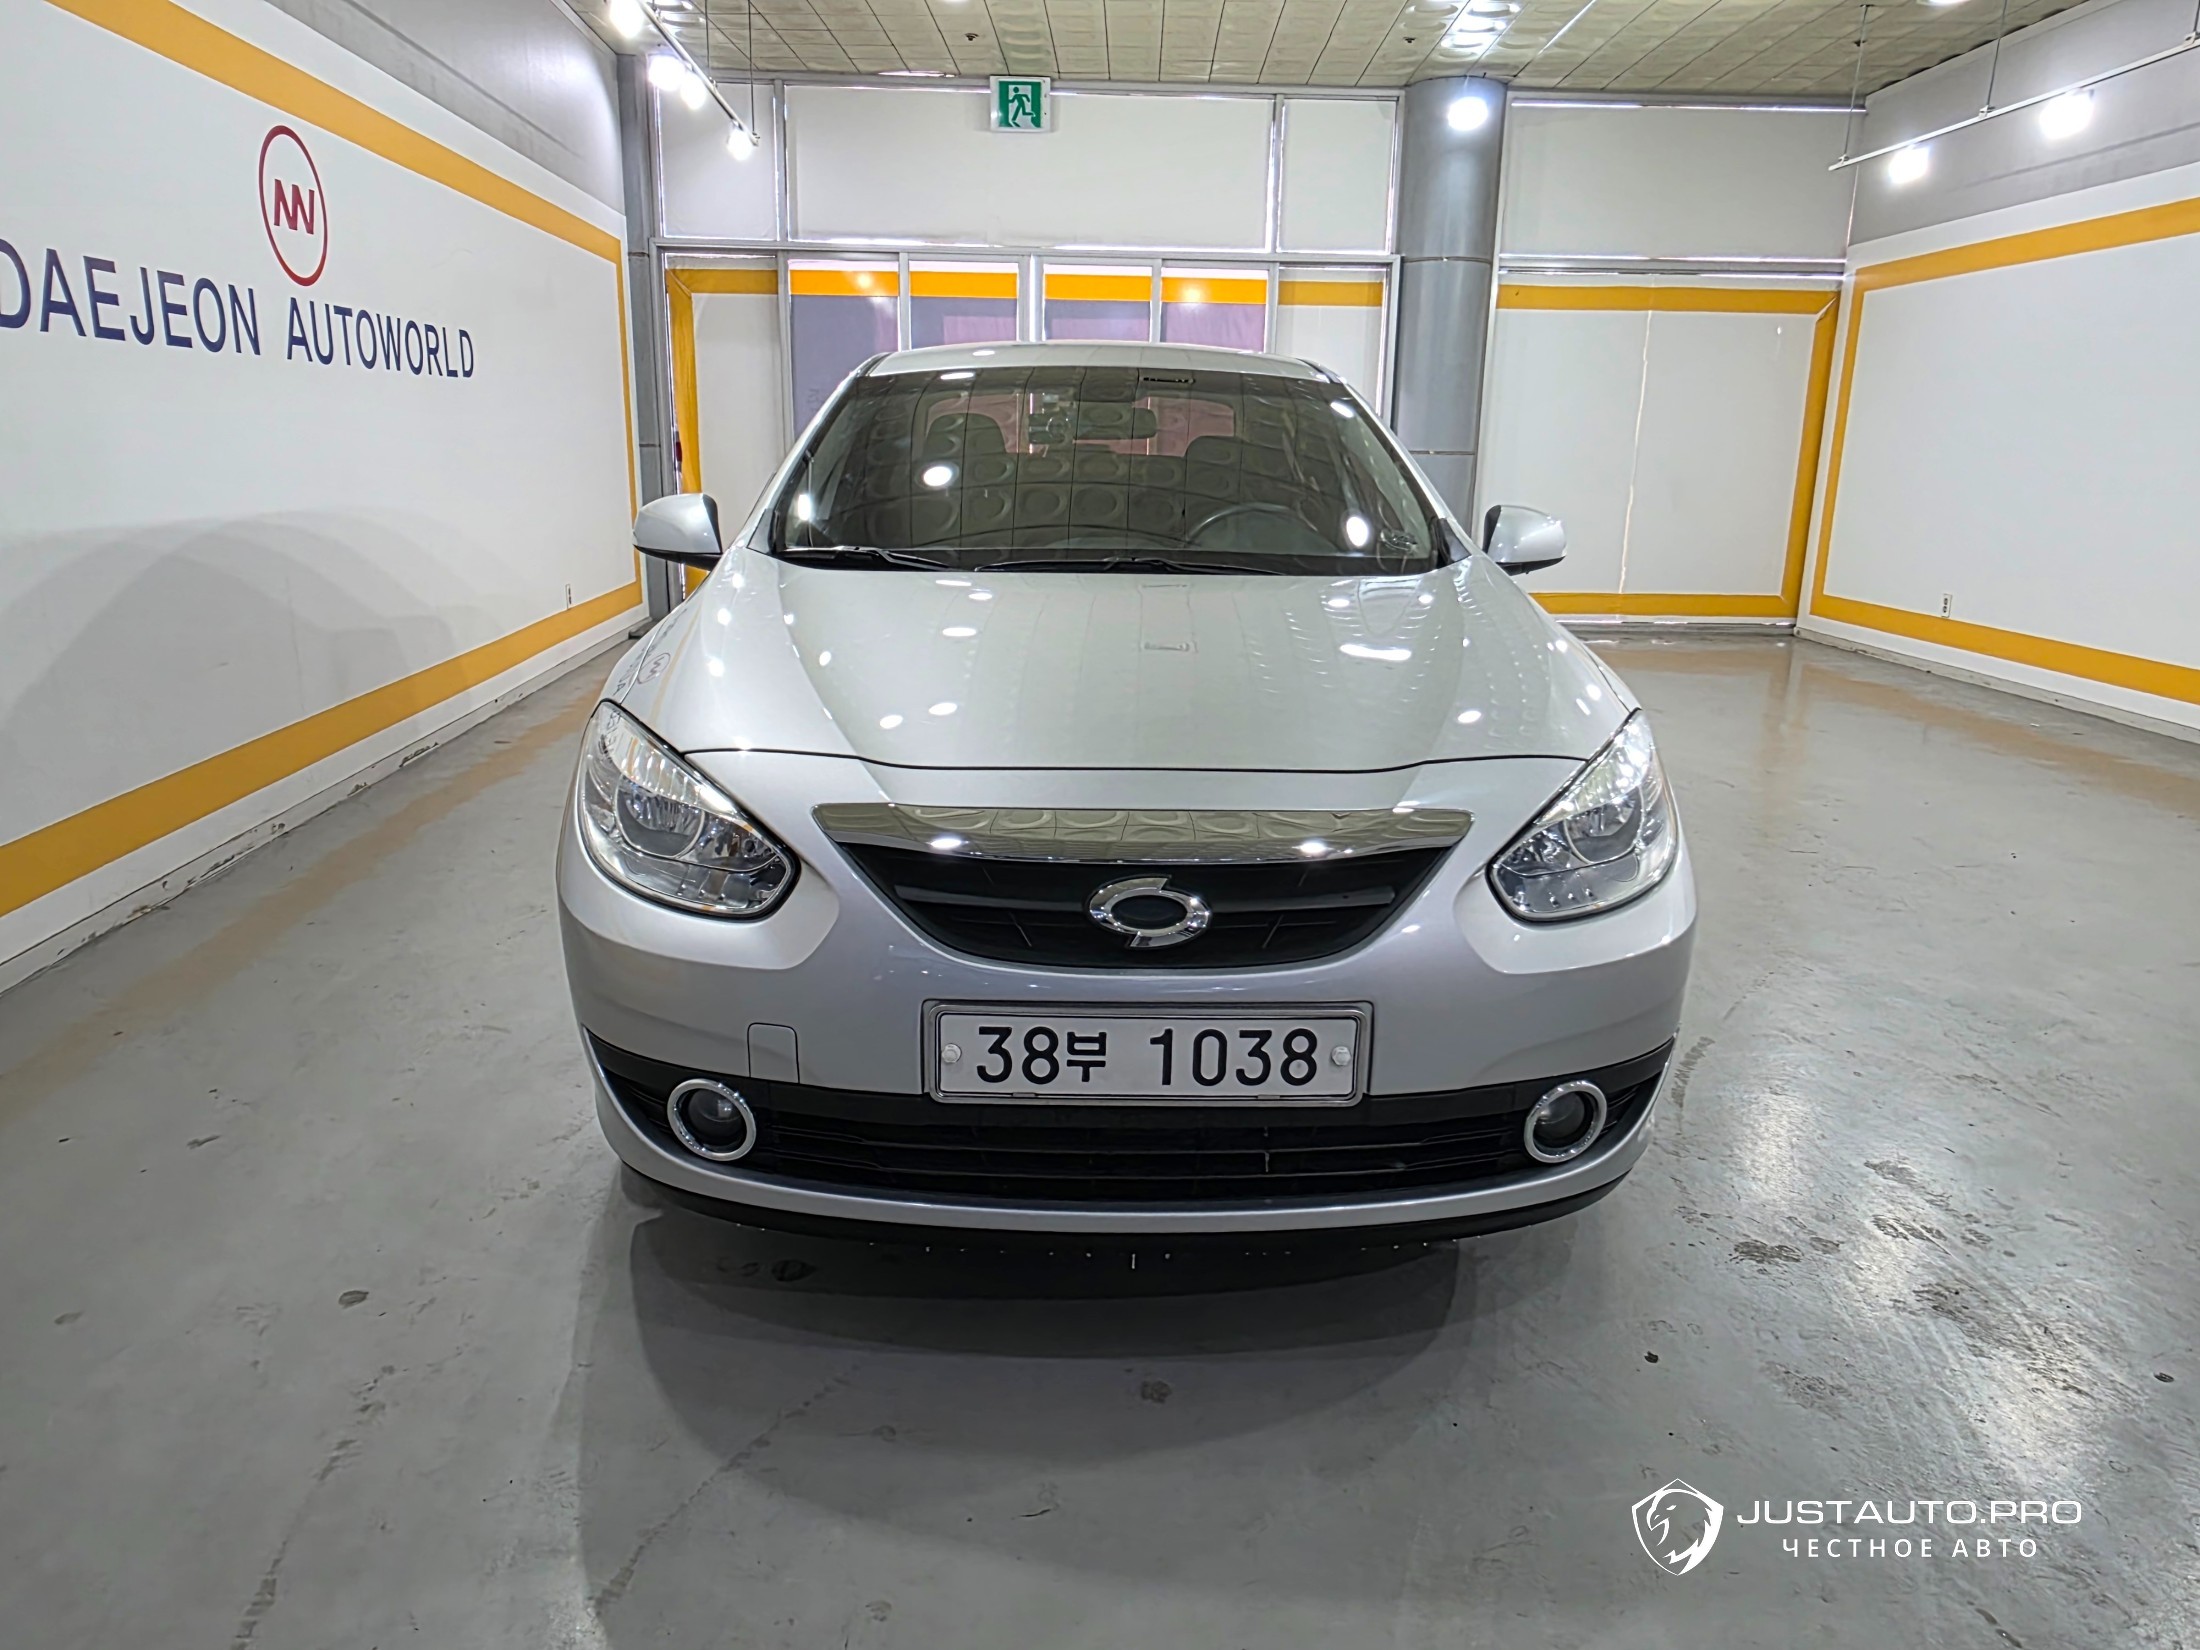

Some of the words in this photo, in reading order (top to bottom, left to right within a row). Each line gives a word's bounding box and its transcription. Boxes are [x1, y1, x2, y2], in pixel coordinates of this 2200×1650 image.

[0, 238, 261, 356] DAEJEON
[287, 297, 474, 378] AUTOWORLD
[976, 1026, 1107, 1085] 38부
[1149, 1028, 1318, 1087] 1038
